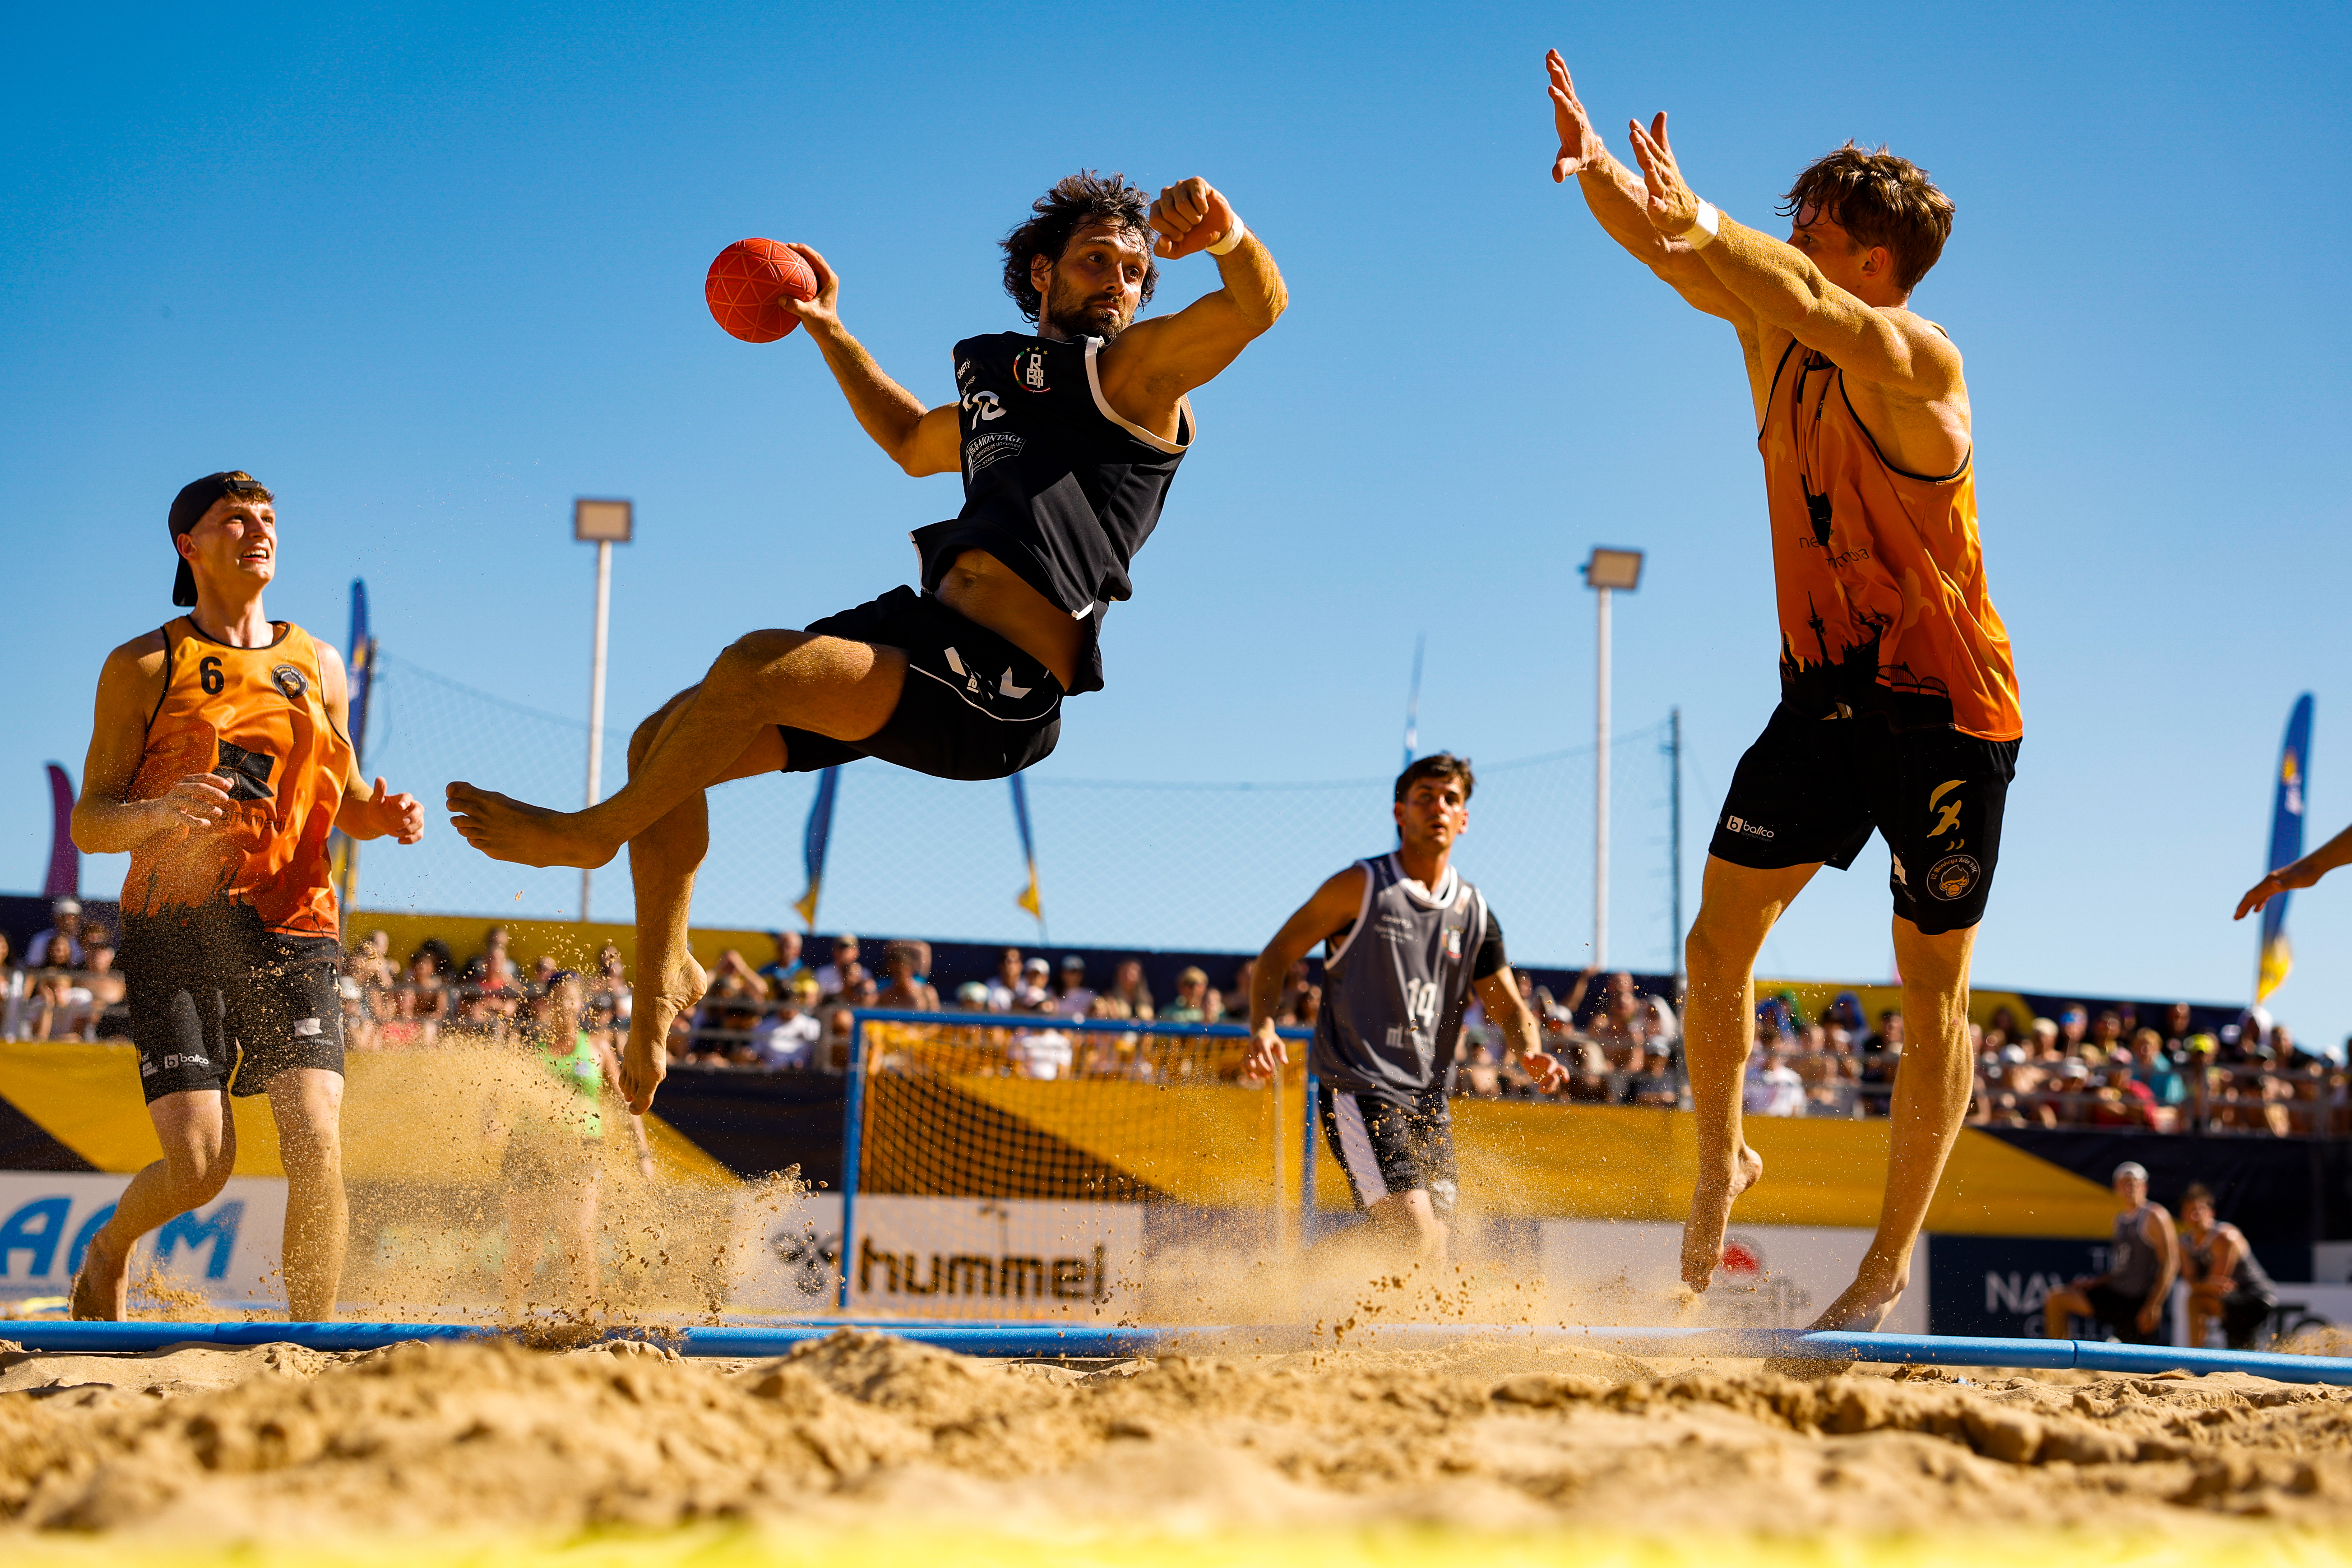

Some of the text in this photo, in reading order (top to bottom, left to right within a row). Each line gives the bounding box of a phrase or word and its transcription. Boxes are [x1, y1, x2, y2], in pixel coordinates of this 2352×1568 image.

[957, 361, 968, 379] CRAFT
[974, 442, 979, 451] &
[978, 435, 1023, 448] MONTAGE
[199, 656, 224, 695] 6
[1744, 821, 1774, 838] ballco
[1933, 858, 1958, 873] Monkeys
[1407, 977, 1438, 1027] 14
[180, 1054, 209, 1065] ballco
[860, 1235, 1107, 1301] hummel
